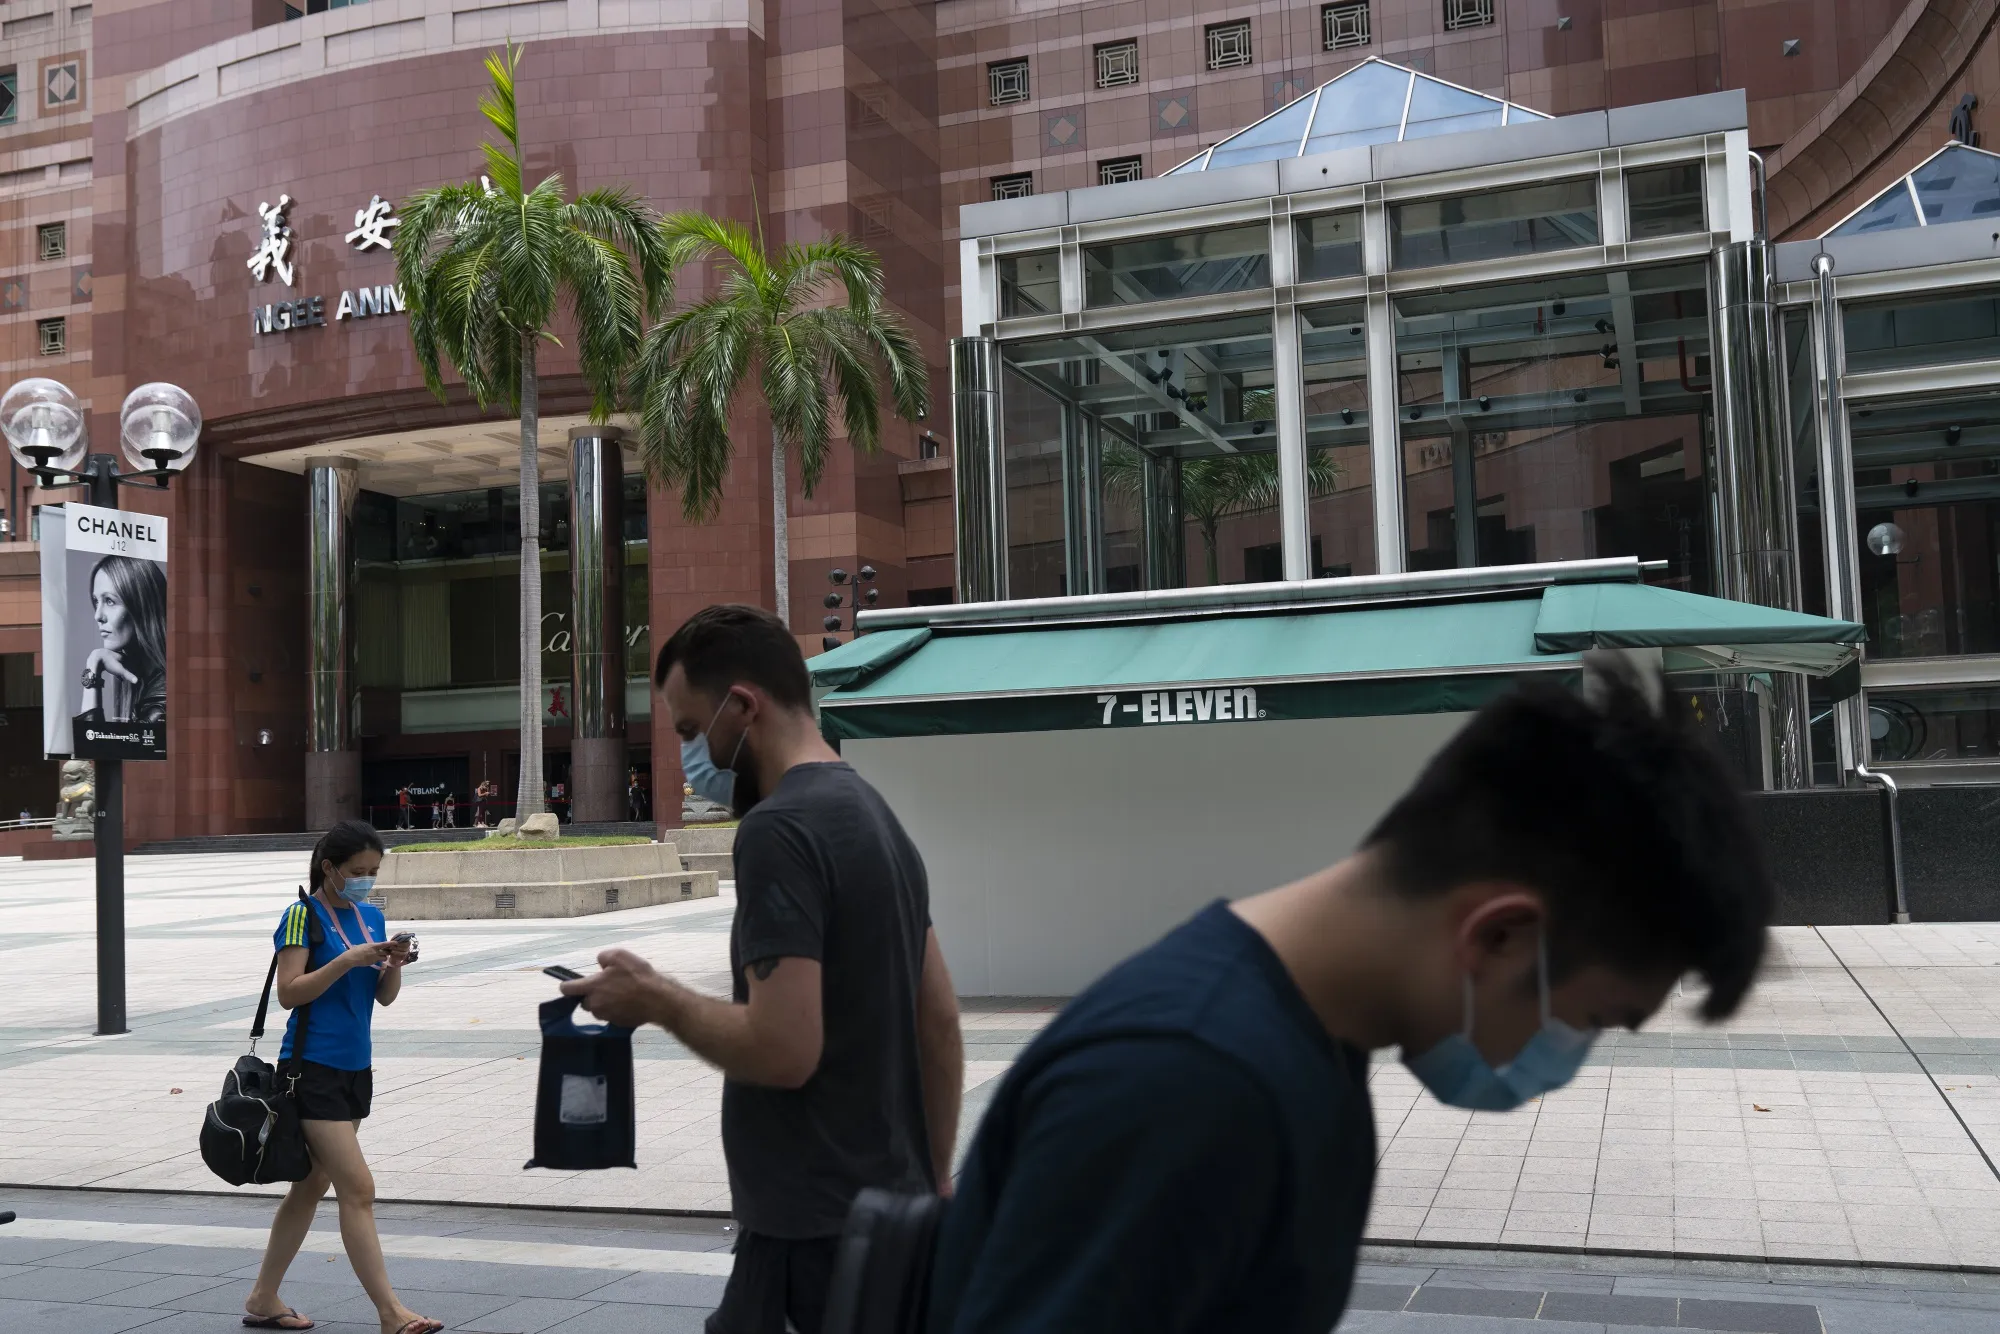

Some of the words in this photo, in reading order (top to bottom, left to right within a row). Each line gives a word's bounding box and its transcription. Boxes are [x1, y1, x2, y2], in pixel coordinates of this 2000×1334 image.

[254, 296, 327, 334] NGEE
[335, 283, 406, 321] ANN
[78, 516, 157, 542] CHANEL
[111, 540, 126, 552] J12
[395, 787, 440, 796] MNTBLANC
